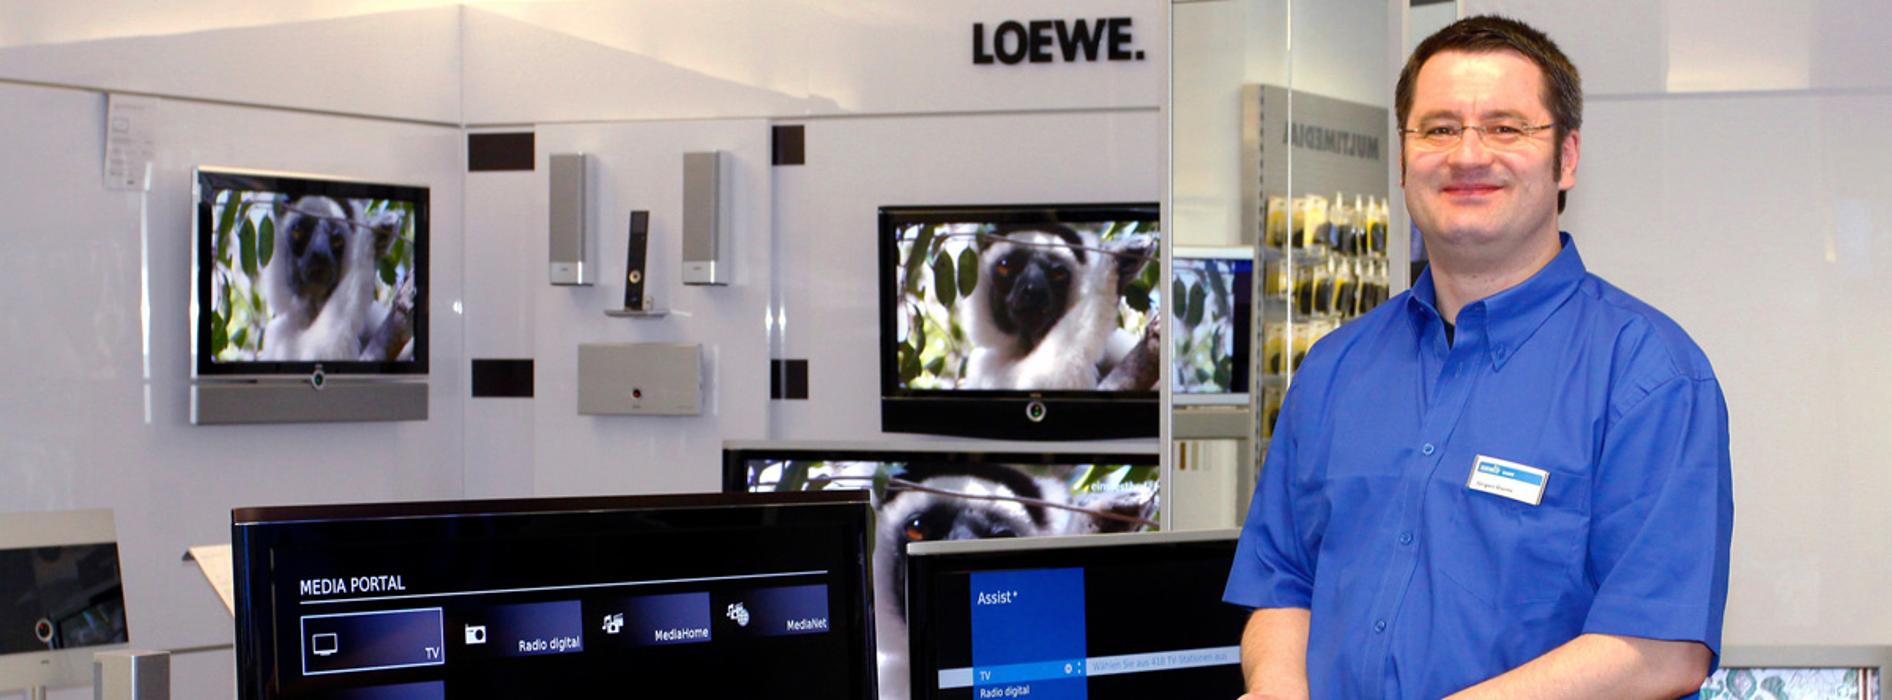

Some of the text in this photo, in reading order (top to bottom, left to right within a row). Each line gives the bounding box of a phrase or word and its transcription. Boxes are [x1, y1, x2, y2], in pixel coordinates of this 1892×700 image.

[973, 17, 1145, 65] LOEWE.
[300, 575, 406, 596] MEDIA PORTAL
[786, 617, 827, 631] MediaNet
[655, 628, 709, 641] MediaHome
[518, 635, 580, 653] Radio digital
[425, 647, 440, 660] TV
[980, 670, 991, 681] TV
[980, 684, 1030, 699] Radio digital
